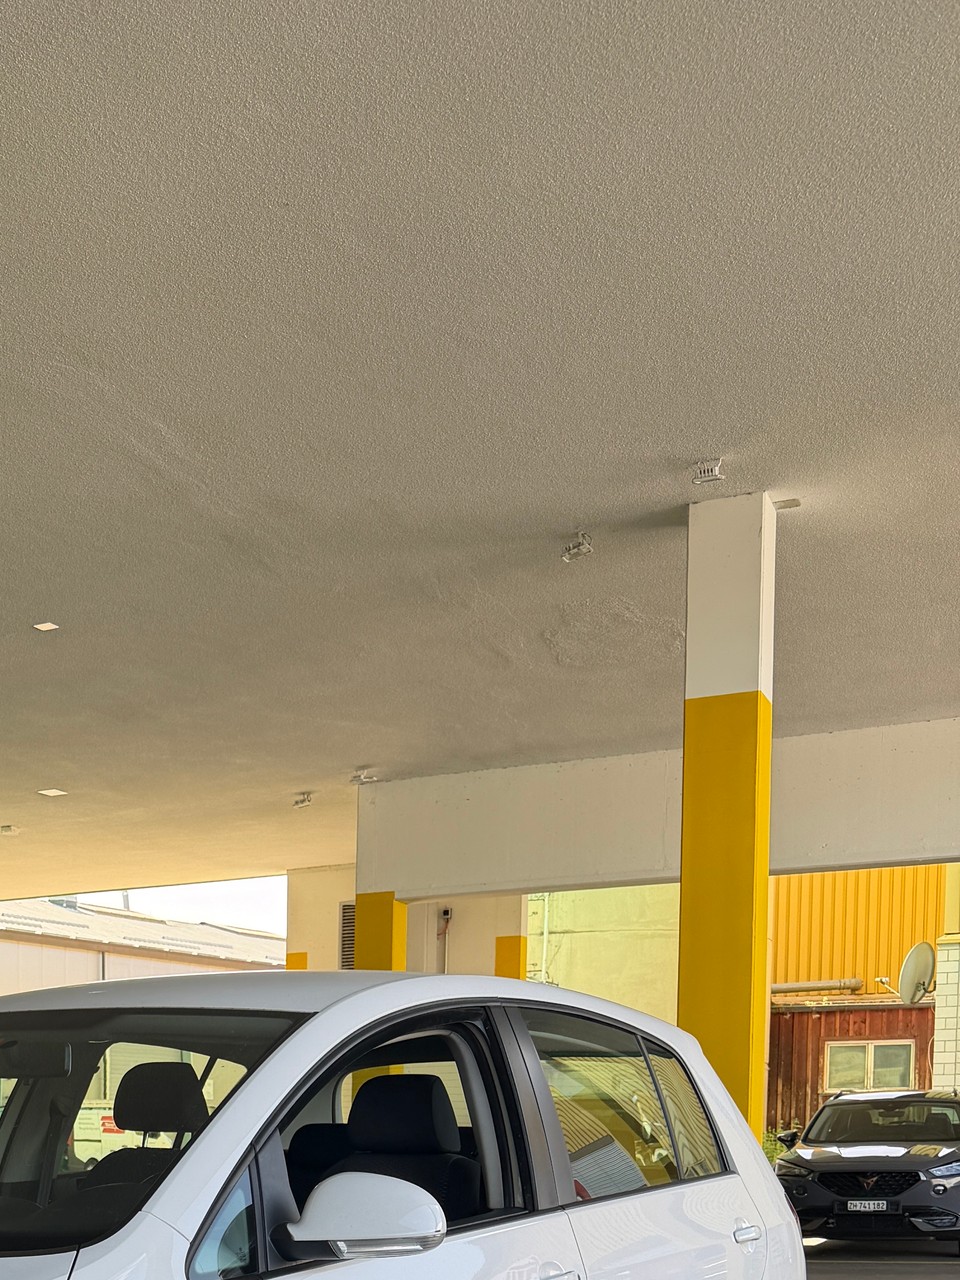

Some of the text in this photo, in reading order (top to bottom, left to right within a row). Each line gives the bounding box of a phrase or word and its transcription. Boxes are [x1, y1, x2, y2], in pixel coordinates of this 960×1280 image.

[848, 1202, 885, 1210] ZH 741 182
